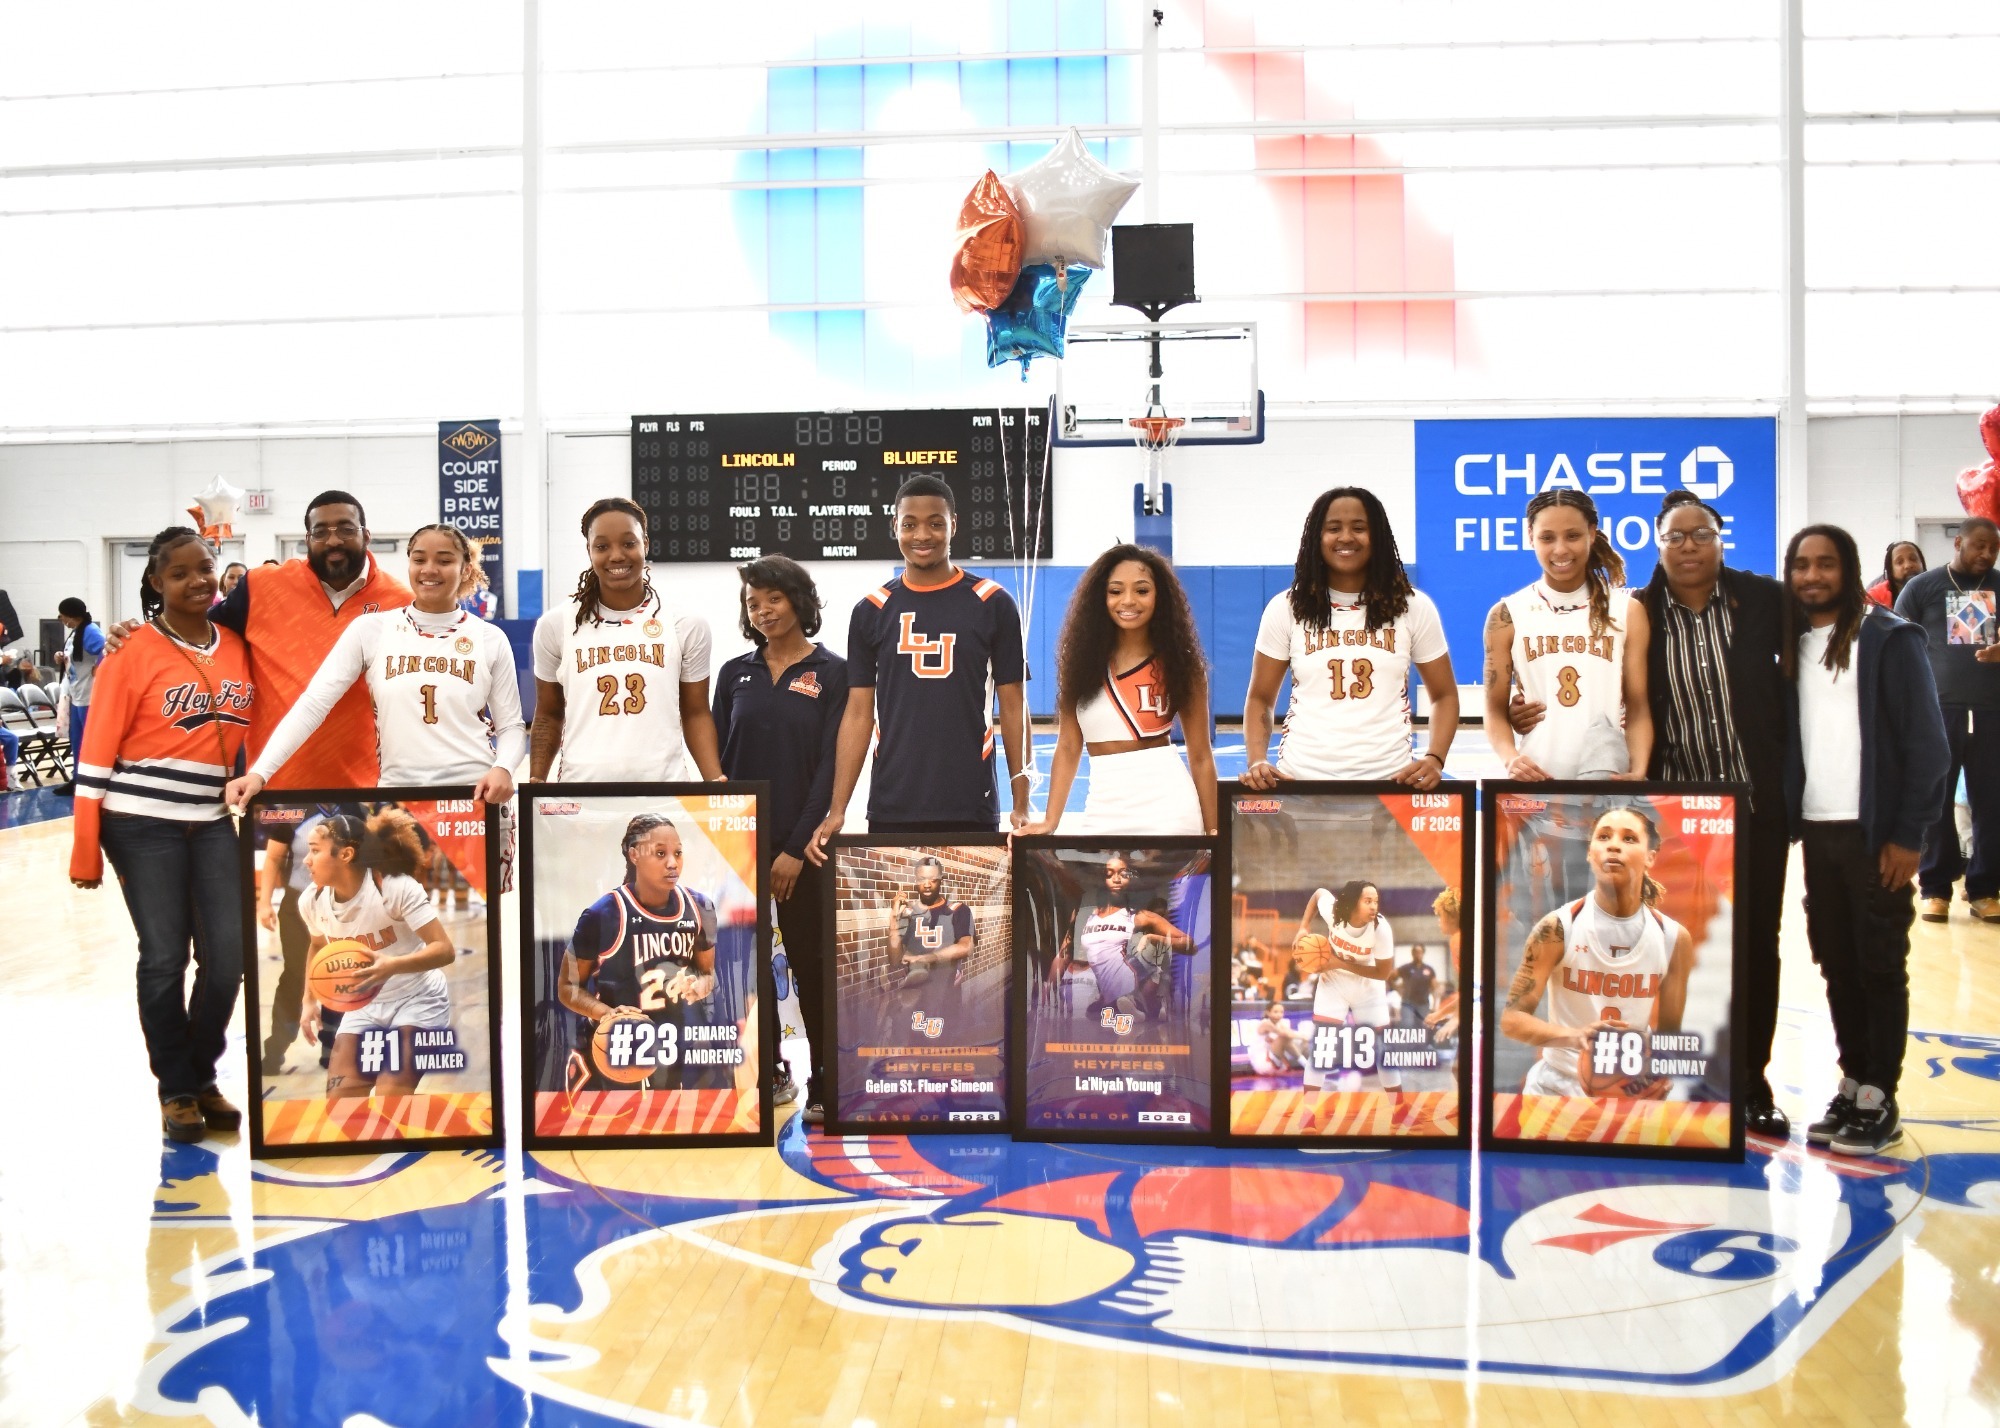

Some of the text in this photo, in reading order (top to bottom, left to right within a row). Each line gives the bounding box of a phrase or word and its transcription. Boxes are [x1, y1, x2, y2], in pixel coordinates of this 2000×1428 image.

[639, 421, 705, 432] PLYR FLS PTS
[973, 415, 1040, 426] PLYR FLS PTS
[722, 453, 795, 467] LINCOLN
[822, 460, 857, 471] PERIOD
[883, 450, 957, 465] BLUEFIE
[442, 460, 499, 476] COURT
[1454, 452, 1667, 495] CHASE
[454, 479, 488, 494] SIDE
[444, 496, 500, 512] BREW
[729, 505, 798, 517] FOULS T.O.L.
[809, 505, 846, 516] PLAYER
[847, 505, 873, 516] FOUL
[443, 514, 500, 530] HOUSE
[730, 547, 761, 558] SCORE
[823, 545, 857, 557] MATCH
[897, 611, 957, 679] LU
[1305, 628, 1396, 656] LINCOLN
[1523, 636, 1615, 663] LINCOLN
[576, 644, 665, 673] LINCOLN
[385, 655, 476, 684] LINCOLN
[1327, 658, 1374, 700] 13
[1556, 665, 1582, 708] 8
[162, 682, 212, 718] Hey
[597, 673, 647, 716] 23
[420, 684, 439, 724] 1
[436, 800, 474, 813] CLASS
[709, 795, 746, 808] CLASS
[1412, 794, 1449, 808] CLASS
[1682, 796, 1721, 810] CLASS
[437, 820, 486, 837] OF 2026
[709, 816, 756, 831] OF 2026
[1412, 816, 1461, 831] OF 2026
[1682, 818, 1734, 834] OF 2026
[1562, 966, 1663, 998] LINCOLN
[361, 1030, 454, 1072] #1 ALAILA
[609, 1022, 737, 1066] #23 DEMARIS
[1313, 1026, 1376, 1069] #13
[1383, 1028, 1426, 1044] KAZIAH
[415, 1053, 464, 1070] WALKER
[684, 1049, 743, 1065] ANDREWS
[1383, 1051, 1437, 1067] AKINNIYI
[1594, 1031, 1699, 1076] #8 HUNTER
[885, 1062, 975, 1072] HEYFEFES
[1074, 1059, 1165, 1071] HEYFEFES
[1651, 1058, 1707, 1076] CONWAY
[866, 1079, 994, 1093] Gelen St. Fluer Simeon
[1075, 1076, 1162, 1095] La'Niyah Young
[1043, 1111, 1186, 1122] CLASS OF 2026
